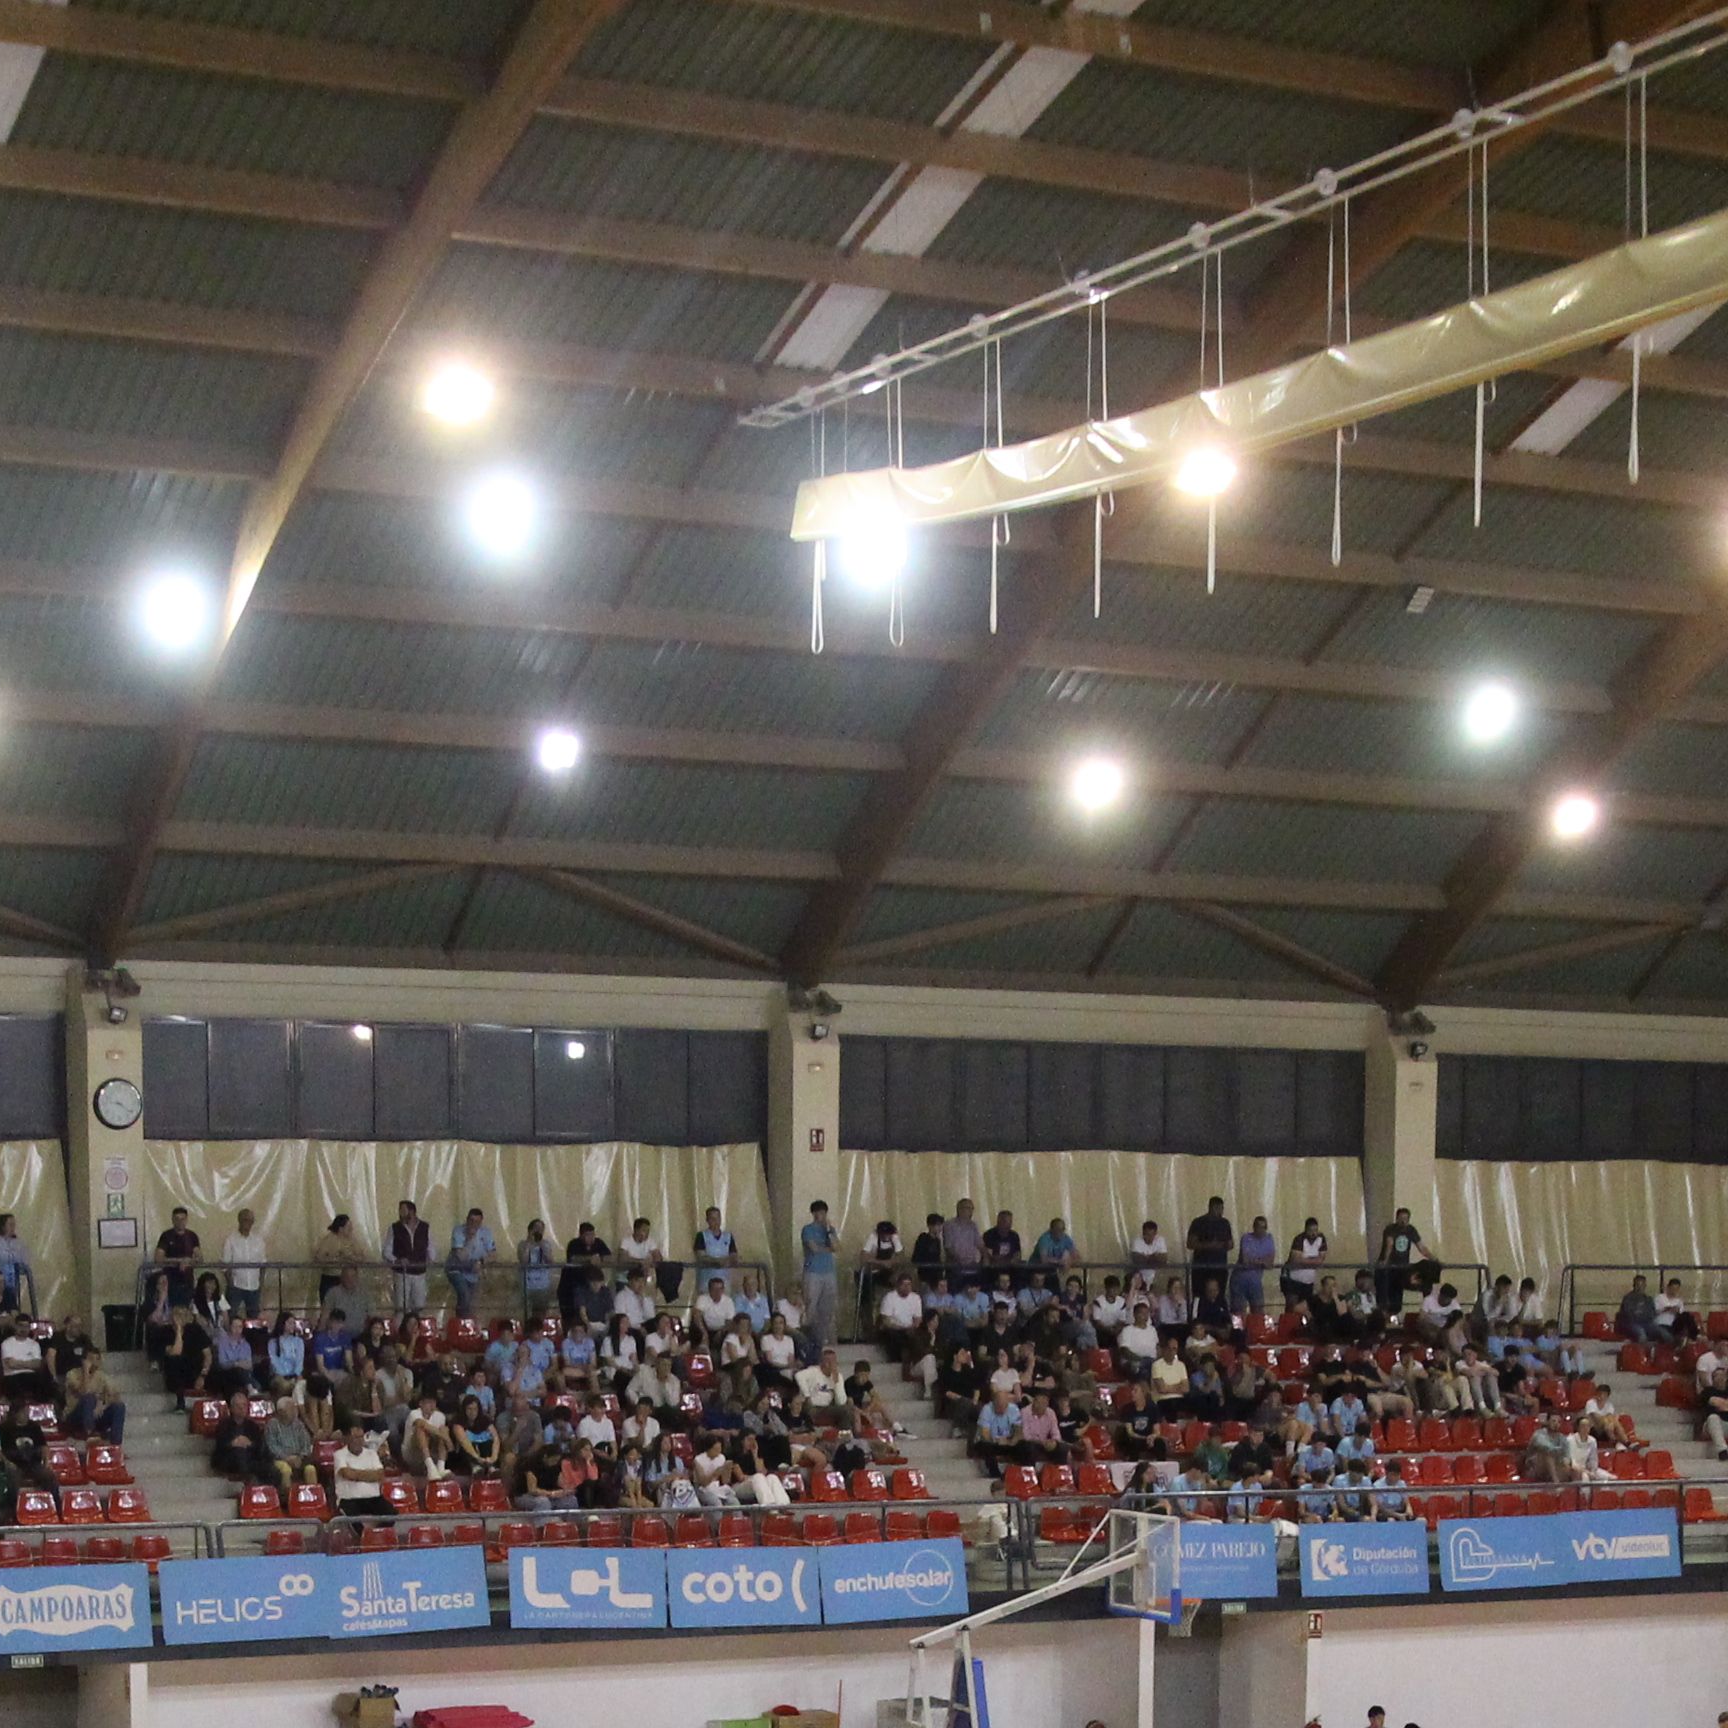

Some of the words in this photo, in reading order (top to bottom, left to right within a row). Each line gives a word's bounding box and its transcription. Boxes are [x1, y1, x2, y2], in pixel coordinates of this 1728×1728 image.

[1212, 1542, 1266, 1558] PAREJO
[1353, 1546, 1417, 1561] Diputación
[682, 1564, 783, 1604] coto
[1, 1592, 127, 1624] CAMPOARAS
